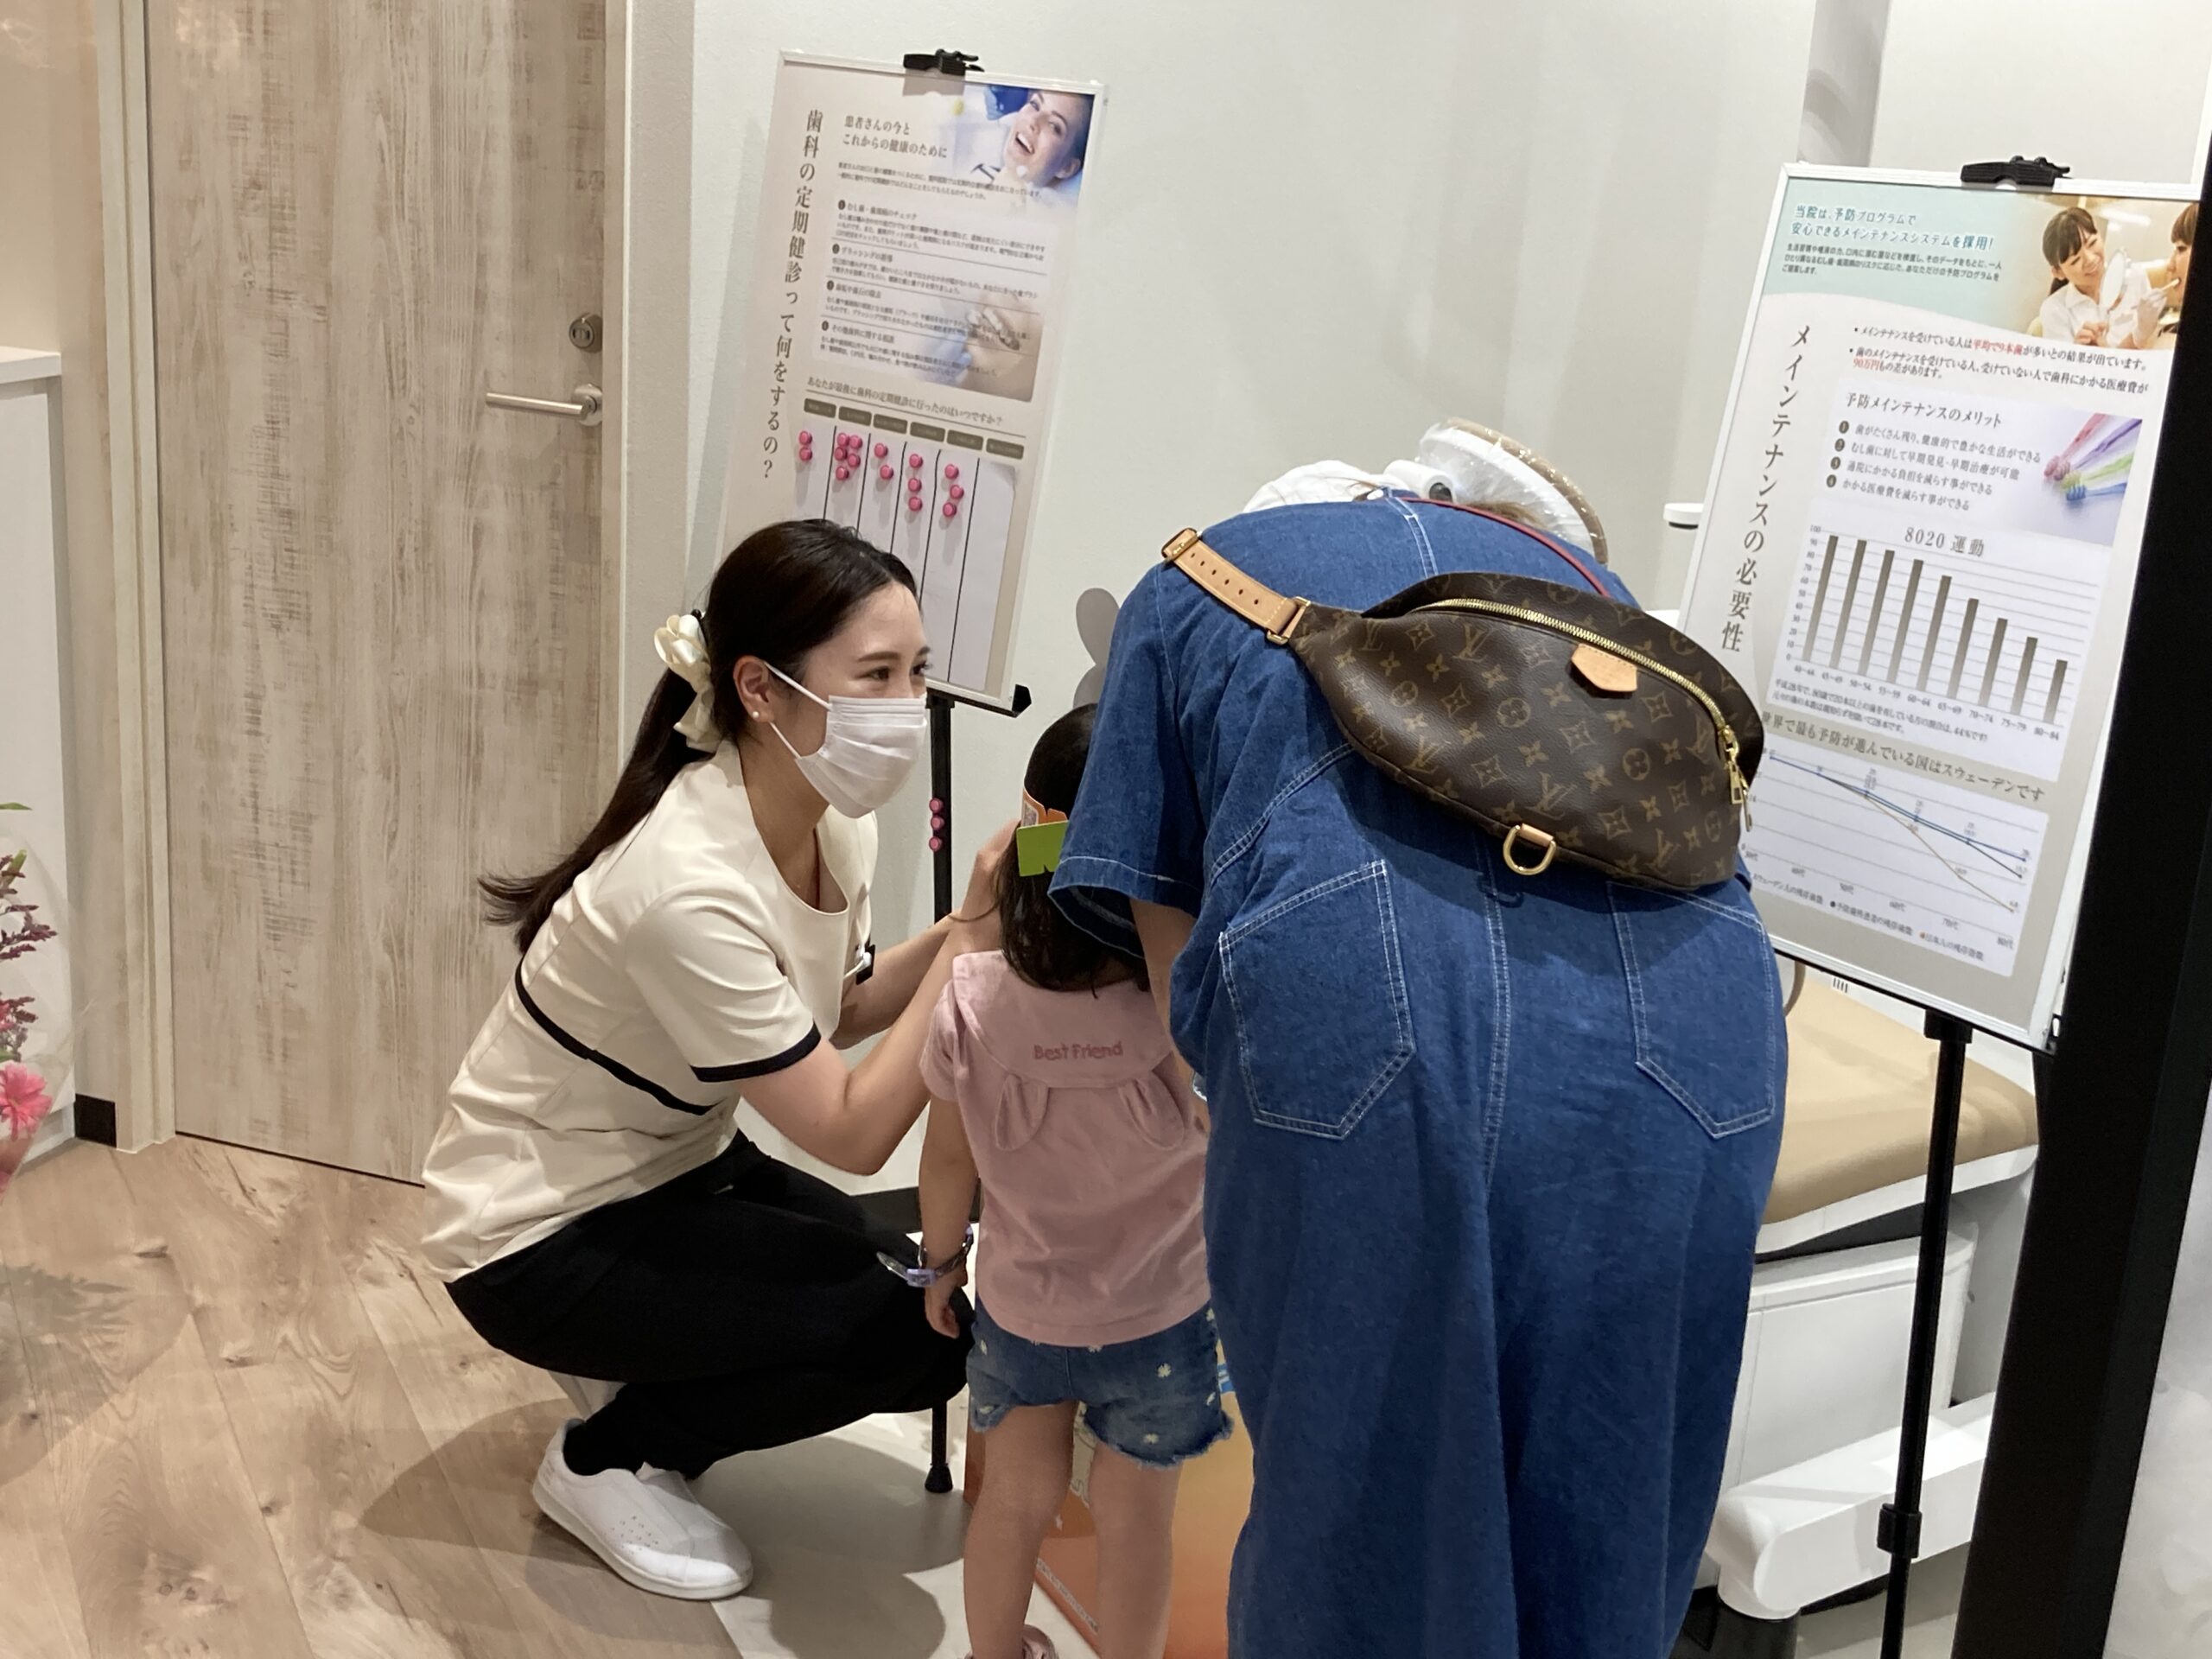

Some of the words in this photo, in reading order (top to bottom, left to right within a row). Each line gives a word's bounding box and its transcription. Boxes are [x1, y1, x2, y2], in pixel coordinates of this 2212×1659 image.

[843, 115, 911, 136] 患者さんの今と
[842, 132, 947, 159] これからの健康のために
[1796, 204, 1916, 226] 当院は、予防プログラムで
[1846, 391, 2002, 429] 予防メインテナンスのメリット
[1721, 325, 1810, 652] メインテナンスの必要性
[1847, 459, 1993, 496] 通院にかかる負担を減らす事ができる
[1842, 478, 1970, 512] かかる医療費を減らす事ができる
[1033, 1043, 1069, 1061] Best
